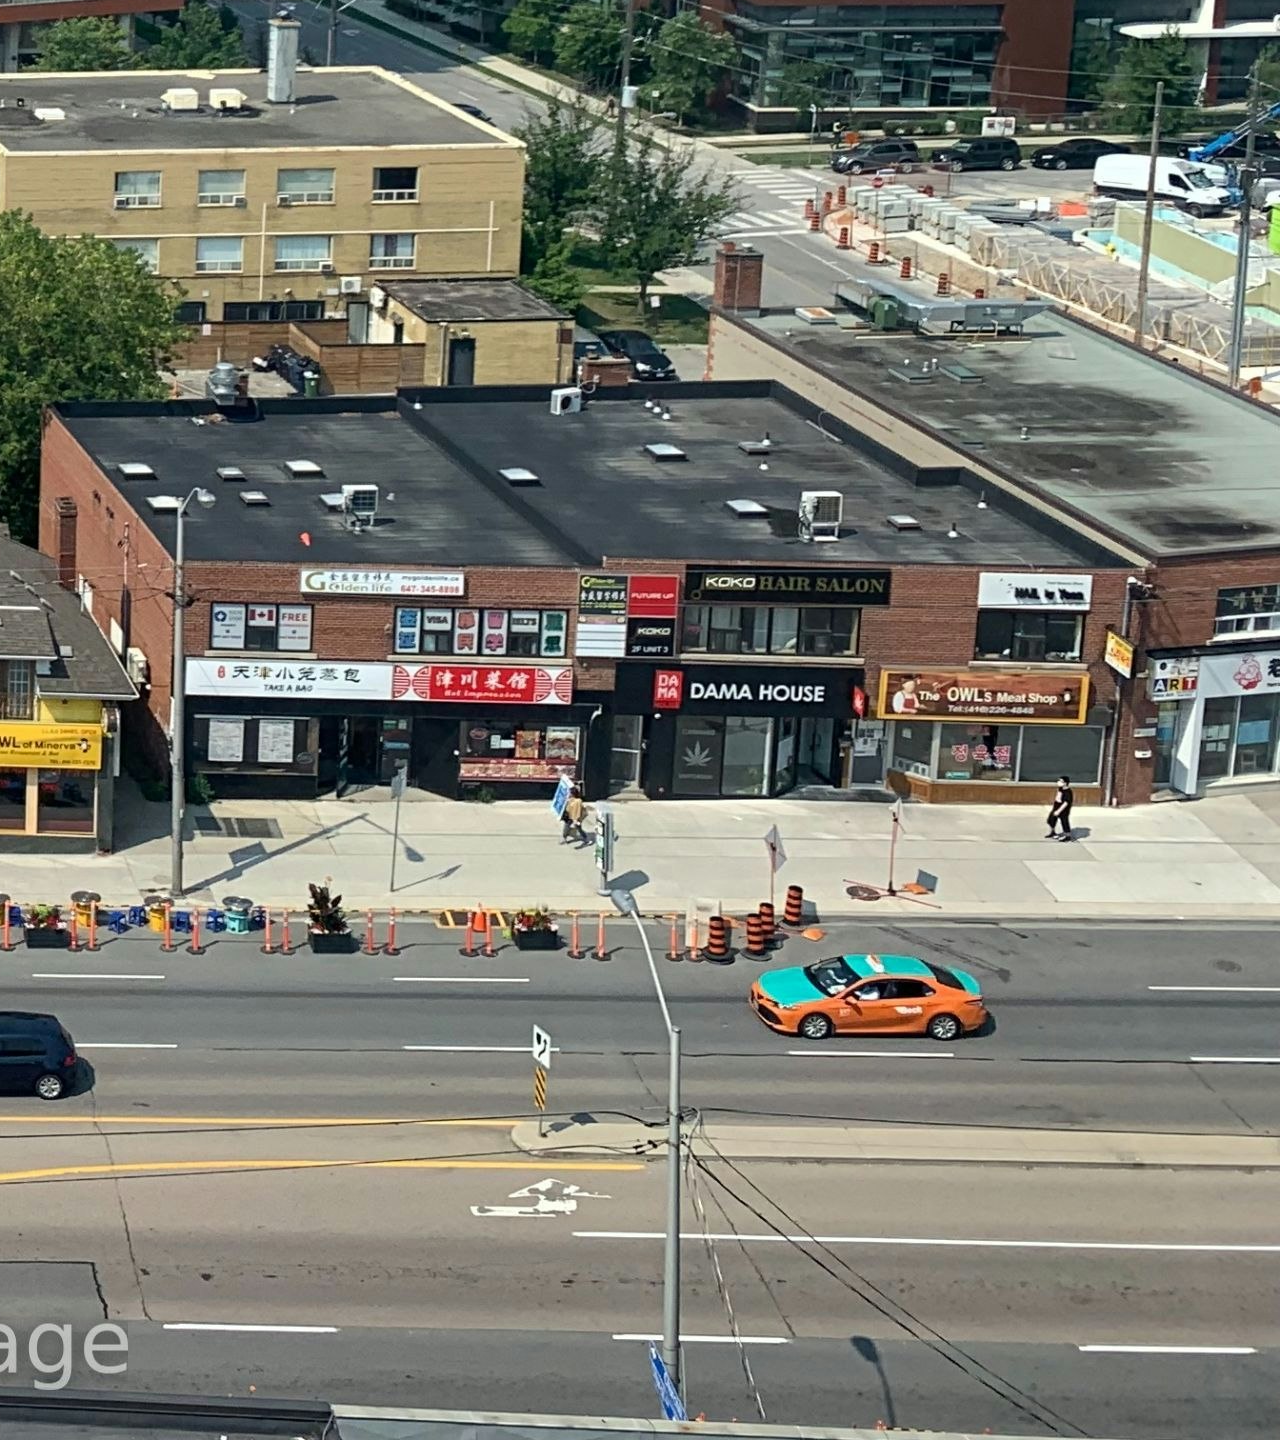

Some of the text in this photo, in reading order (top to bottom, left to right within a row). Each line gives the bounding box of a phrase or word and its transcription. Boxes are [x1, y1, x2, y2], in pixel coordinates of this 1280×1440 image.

[371, 583, 393, 592] life
[705, 575, 886, 593] KOKO HAIR SALON
[282, 613, 308, 622] FREE
[426, 616, 448, 624] VISA
[637, 627, 671, 636] KOKO
[658, 674, 679, 686] DA
[264, 684, 284, 692] TAKE
[657, 686, 678, 699] MA
[690, 683, 825, 702] DAMA HOUSE
[918, 690, 940, 701] The
[996, 692, 1026, 703] Meat
[1027, 693, 1058, 705] Shop
[23, 740, 33, 749] of
[35, 741, 76, 750] Minerva
